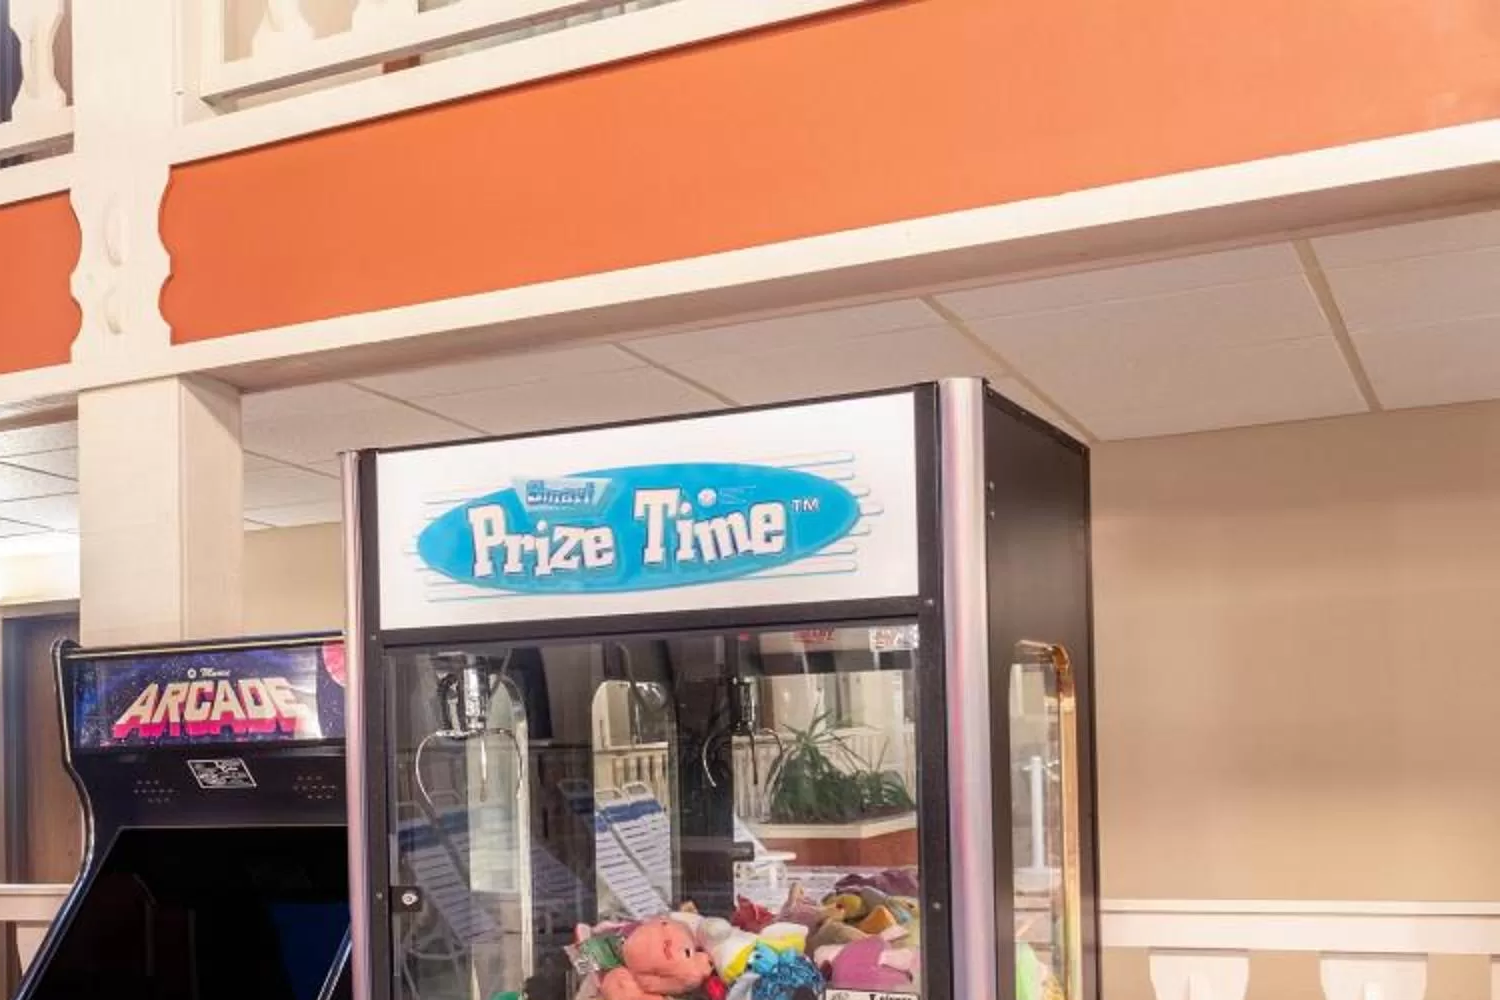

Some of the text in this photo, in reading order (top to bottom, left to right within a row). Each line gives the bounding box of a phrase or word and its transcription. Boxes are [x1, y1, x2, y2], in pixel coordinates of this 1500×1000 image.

[467, 502, 617, 579] Prize
[633, 487, 788, 566] Time
[112, 676, 310, 738] ARCADE
